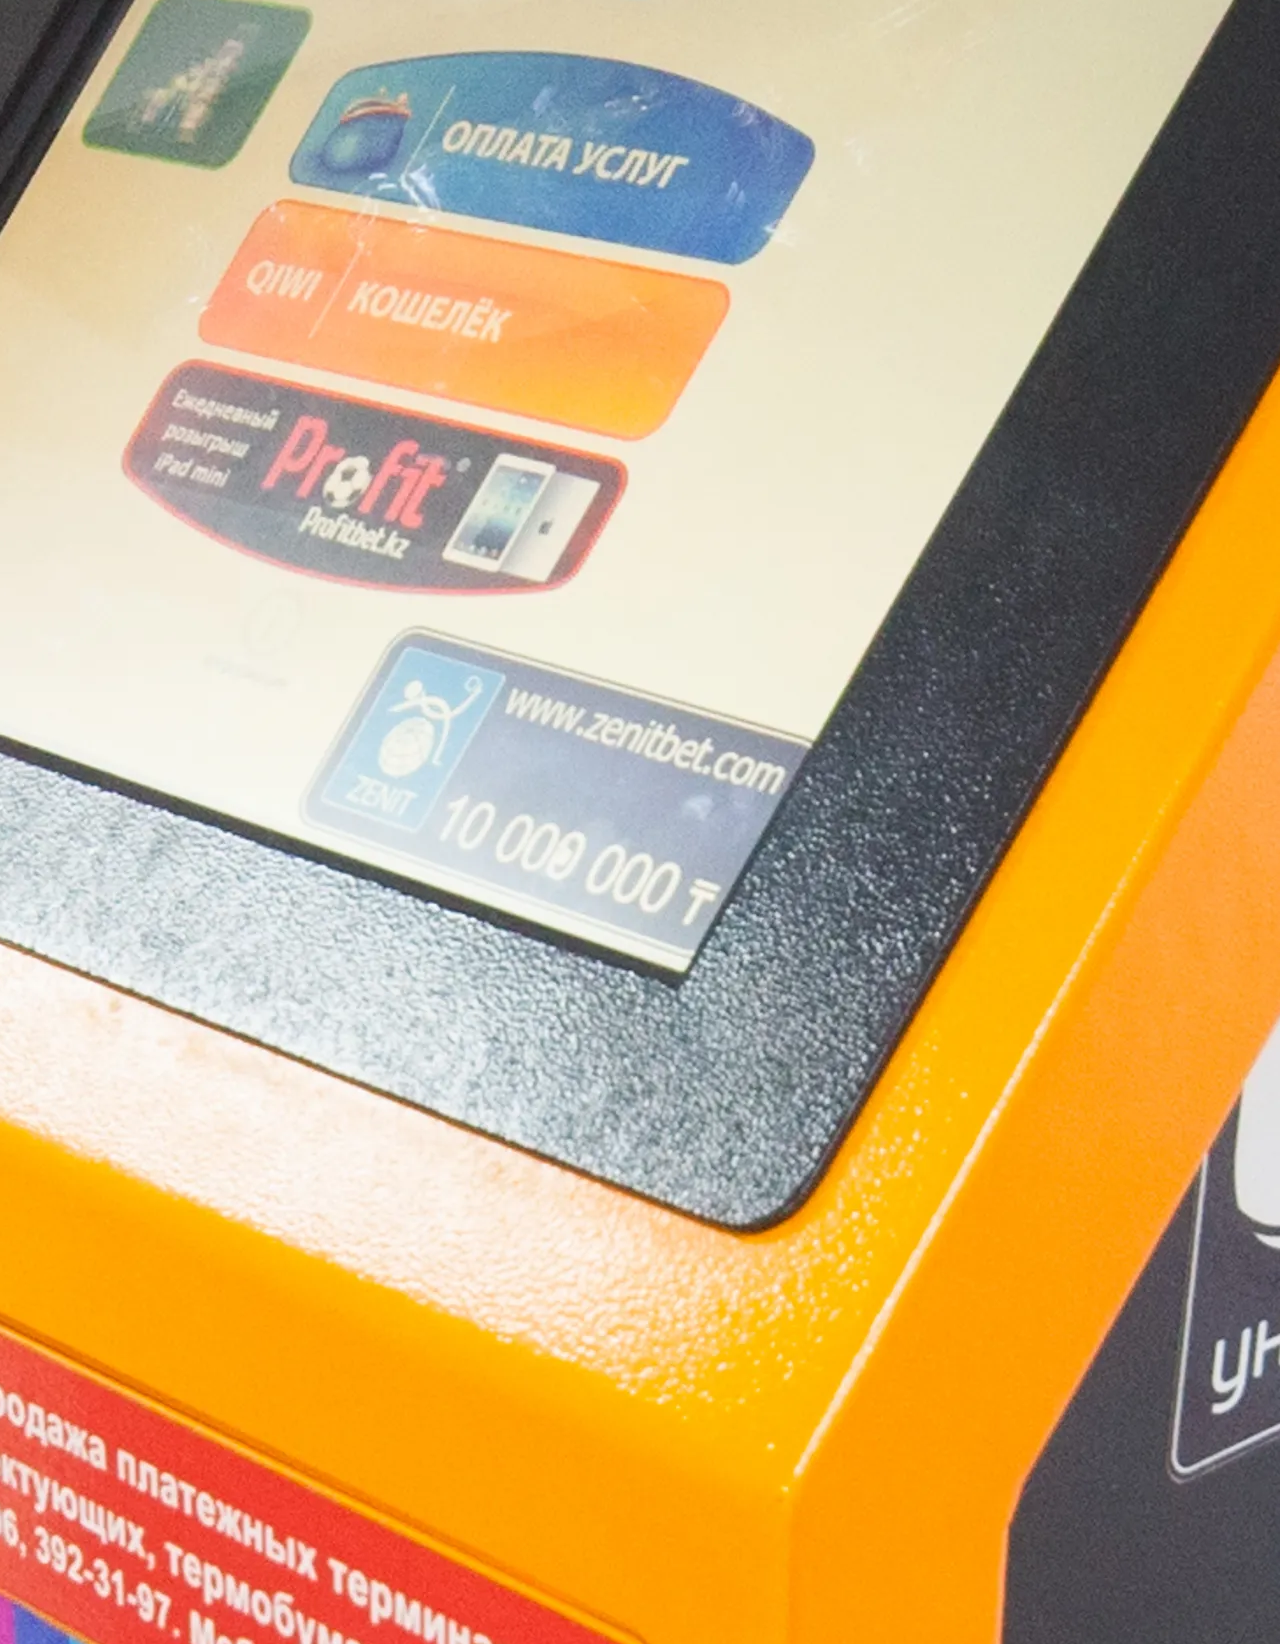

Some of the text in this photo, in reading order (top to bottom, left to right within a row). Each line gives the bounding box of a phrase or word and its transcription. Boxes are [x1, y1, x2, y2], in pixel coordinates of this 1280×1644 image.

[441, 120, 690, 189] ОПЛАТА УСЛУГ
[246, 259, 514, 344] QIWI КОШЕЛЁК
[160, 423, 251, 459] розыгрыш
[171, 388, 281, 432] Ежедневный
[154, 452, 232, 488] iPad mini
[298, 505, 412, 560] Profitbet.kz
[503, 686, 786, 796] www.zenitbet.com
[345, 774, 418, 818] ZENIT
[438, 794, 497, 851] 10
[495, 812, 587, 883] 000
[584, 843, 683, 915] 000
[116, 1447, 318, 1583] платежных
